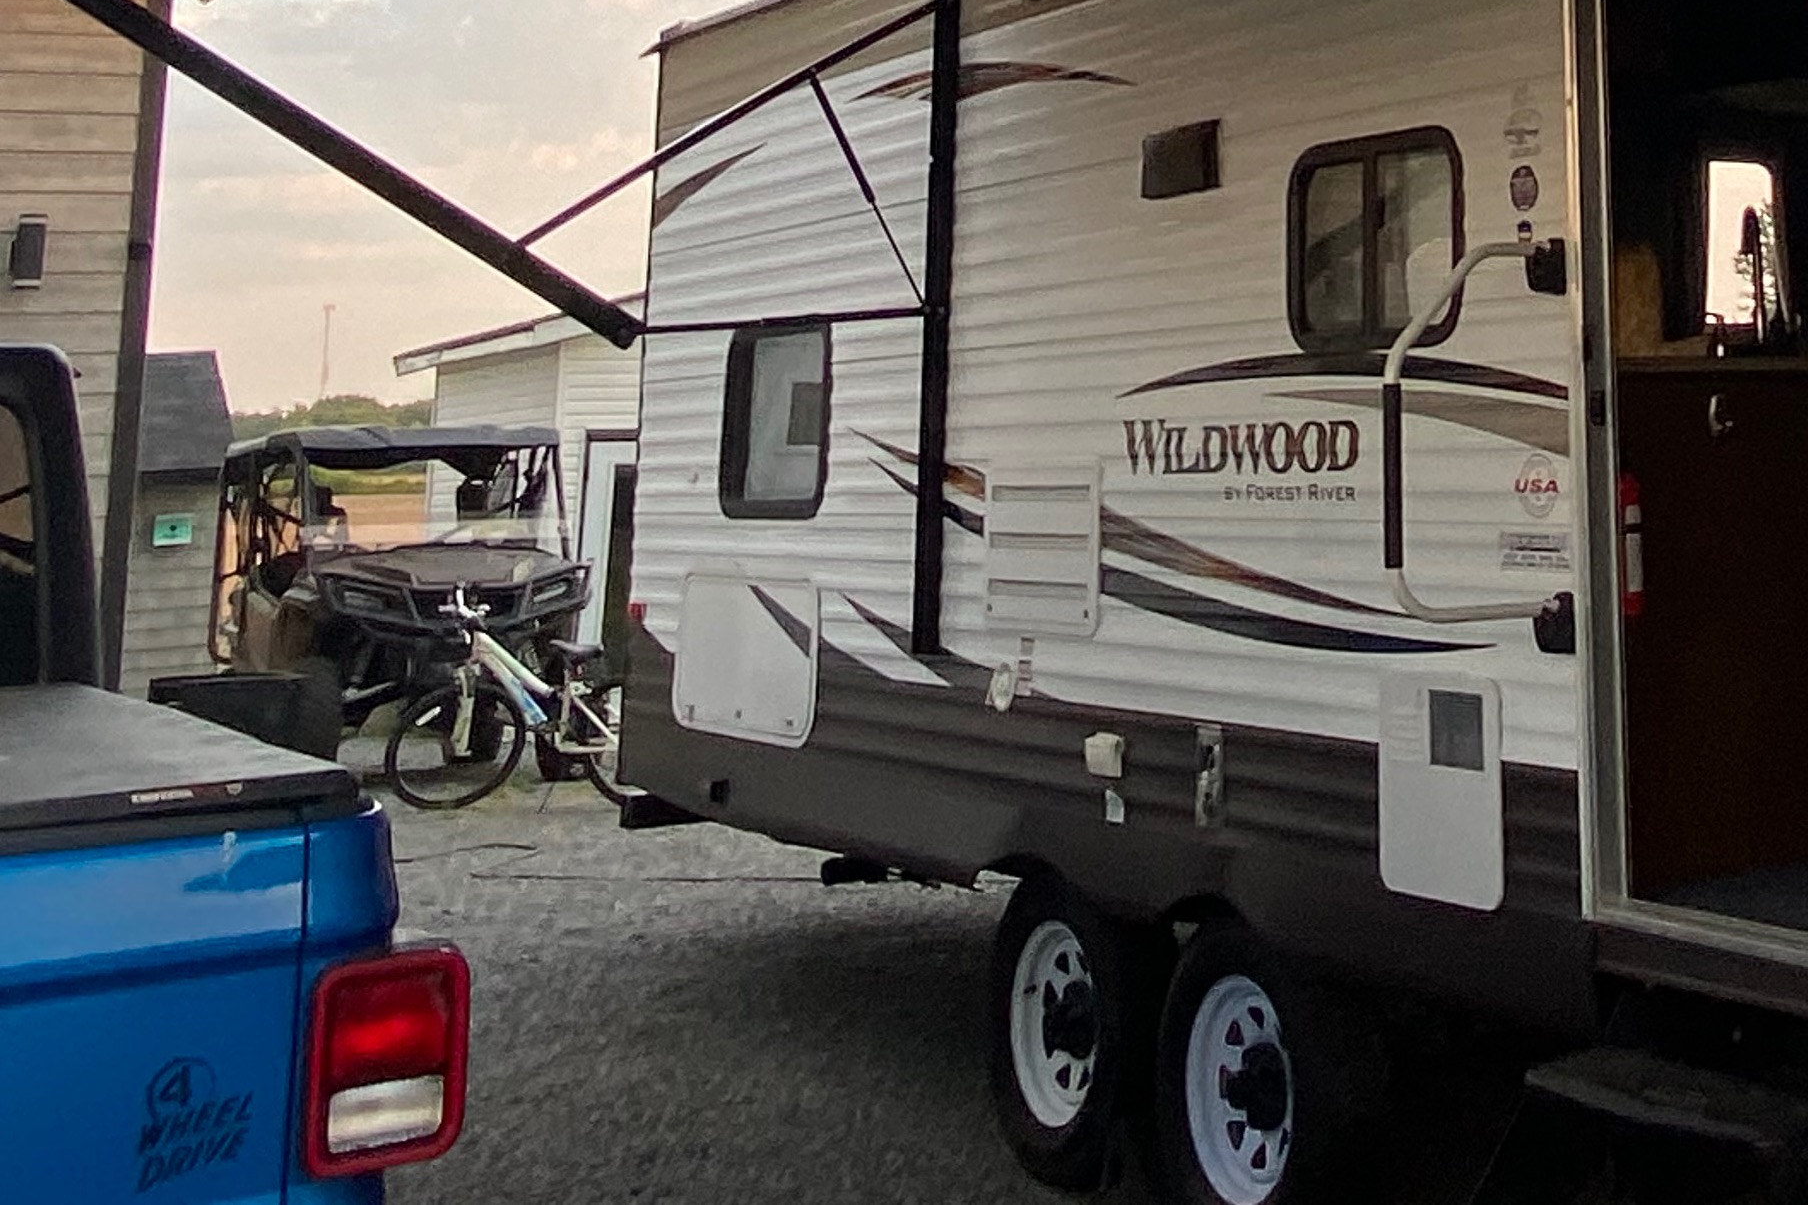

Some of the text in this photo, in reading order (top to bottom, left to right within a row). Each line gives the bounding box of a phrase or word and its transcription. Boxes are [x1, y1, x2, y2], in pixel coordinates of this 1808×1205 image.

[1123, 419, 1360, 476] WILDWOOD
[1245, 483, 1302, 501] FOREST
[1307, 483, 1356, 501] RIVER
[1514, 478, 1560, 493] USA
[159, 1063, 193, 1107] 4
[138, 1090, 254, 1155] WHEEL
[136, 1126, 250, 1194] DRIVE
